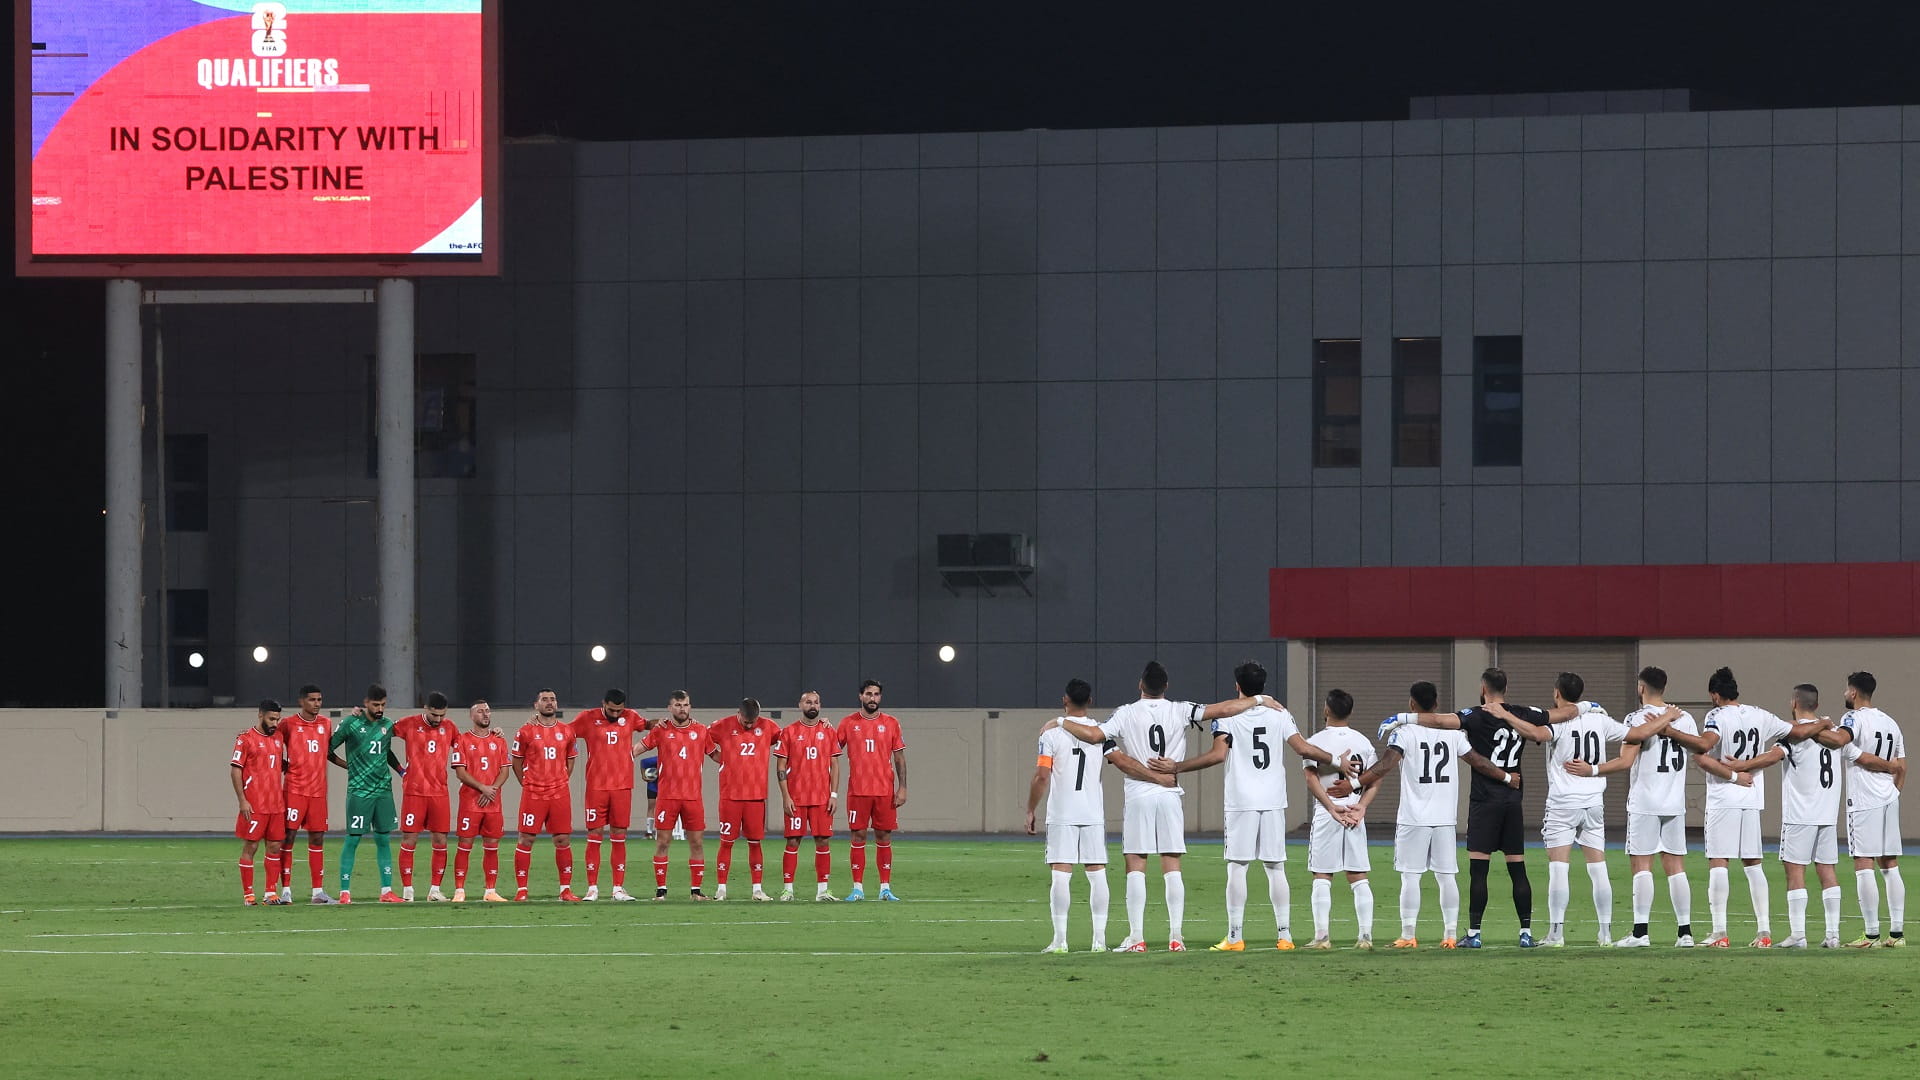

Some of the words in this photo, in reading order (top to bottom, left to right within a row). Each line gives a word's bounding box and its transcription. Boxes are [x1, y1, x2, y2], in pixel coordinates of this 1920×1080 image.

[197, 58, 338, 89] QUALIFIERS
[110, 127, 140, 151] IN
[151, 126, 347, 152] SOLIDARITY
[356, 126, 439, 151] WITH
[186, 166, 364, 191] PALESTINE
[605, 731, 618, 745] 15
[1148, 723, 1166, 758] 9
[1733, 727, 1760, 761] 23
[306, 739, 319, 753] 16
[369, 741, 382, 754] 21
[427, 740, 436, 753] 8
[740, 743, 756, 756] 22
[865, 739, 875, 752] 11
[1252, 726, 1270, 770] 5
[1490, 727, 1522, 768] 22
[1571, 730, 1600, 766] 10
[1874, 731, 1894, 762] 11
[543, 747, 557, 760] 18
[678, 746, 687, 760] 4
[805, 747, 818, 760] 19
[269, 755, 275, 769] 7
[481, 757, 489, 770] 5
[1072, 747, 1086, 791] 7
[1419, 741, 1450, 784] 12
[1819, 748, 1834, 789] 8
[287, 807, 298, 822] 16
[405, 813, 415, 826] 8
[522, 813, 535, 827] 18
[586, 808, 597, 822] 15
[657, 810, 666, 823] 4
[249, 820, 258, 834] 7
[350, 815, 364, 829] 21
[461, 817, 470, 831] 5
[790, 817, 802, 830] 19
